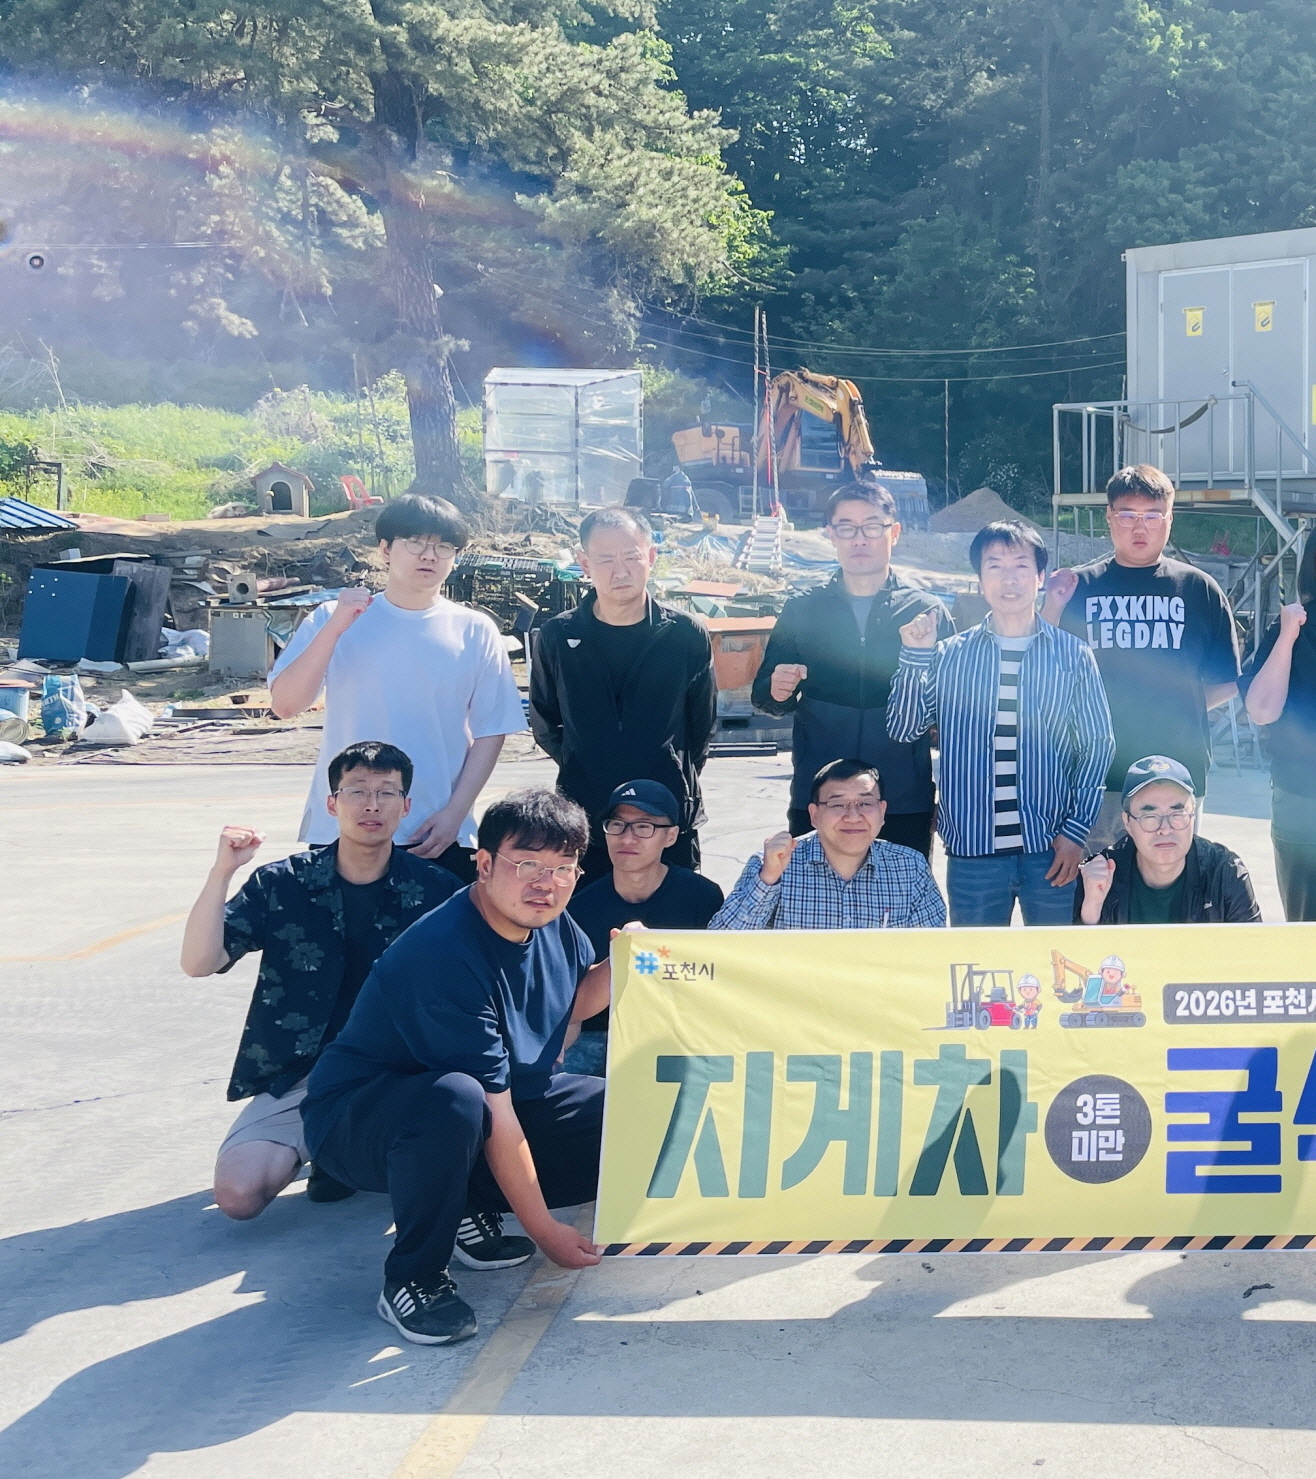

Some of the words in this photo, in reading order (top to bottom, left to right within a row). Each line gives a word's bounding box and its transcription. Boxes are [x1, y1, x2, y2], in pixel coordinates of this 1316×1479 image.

[1085, 595, 1185, 622] FXXKING
[1086, 621, 1185, 650] LEGDAY
[661, 961, 715, 982] 포천시
[1174, 988, 1258, 1017] 2026년
[645, 1043, 1039, 1199] 지게차
[1075, 1092, 1121, 1126] 3톤
[1070, 1129, 1126, 1162] 미만
